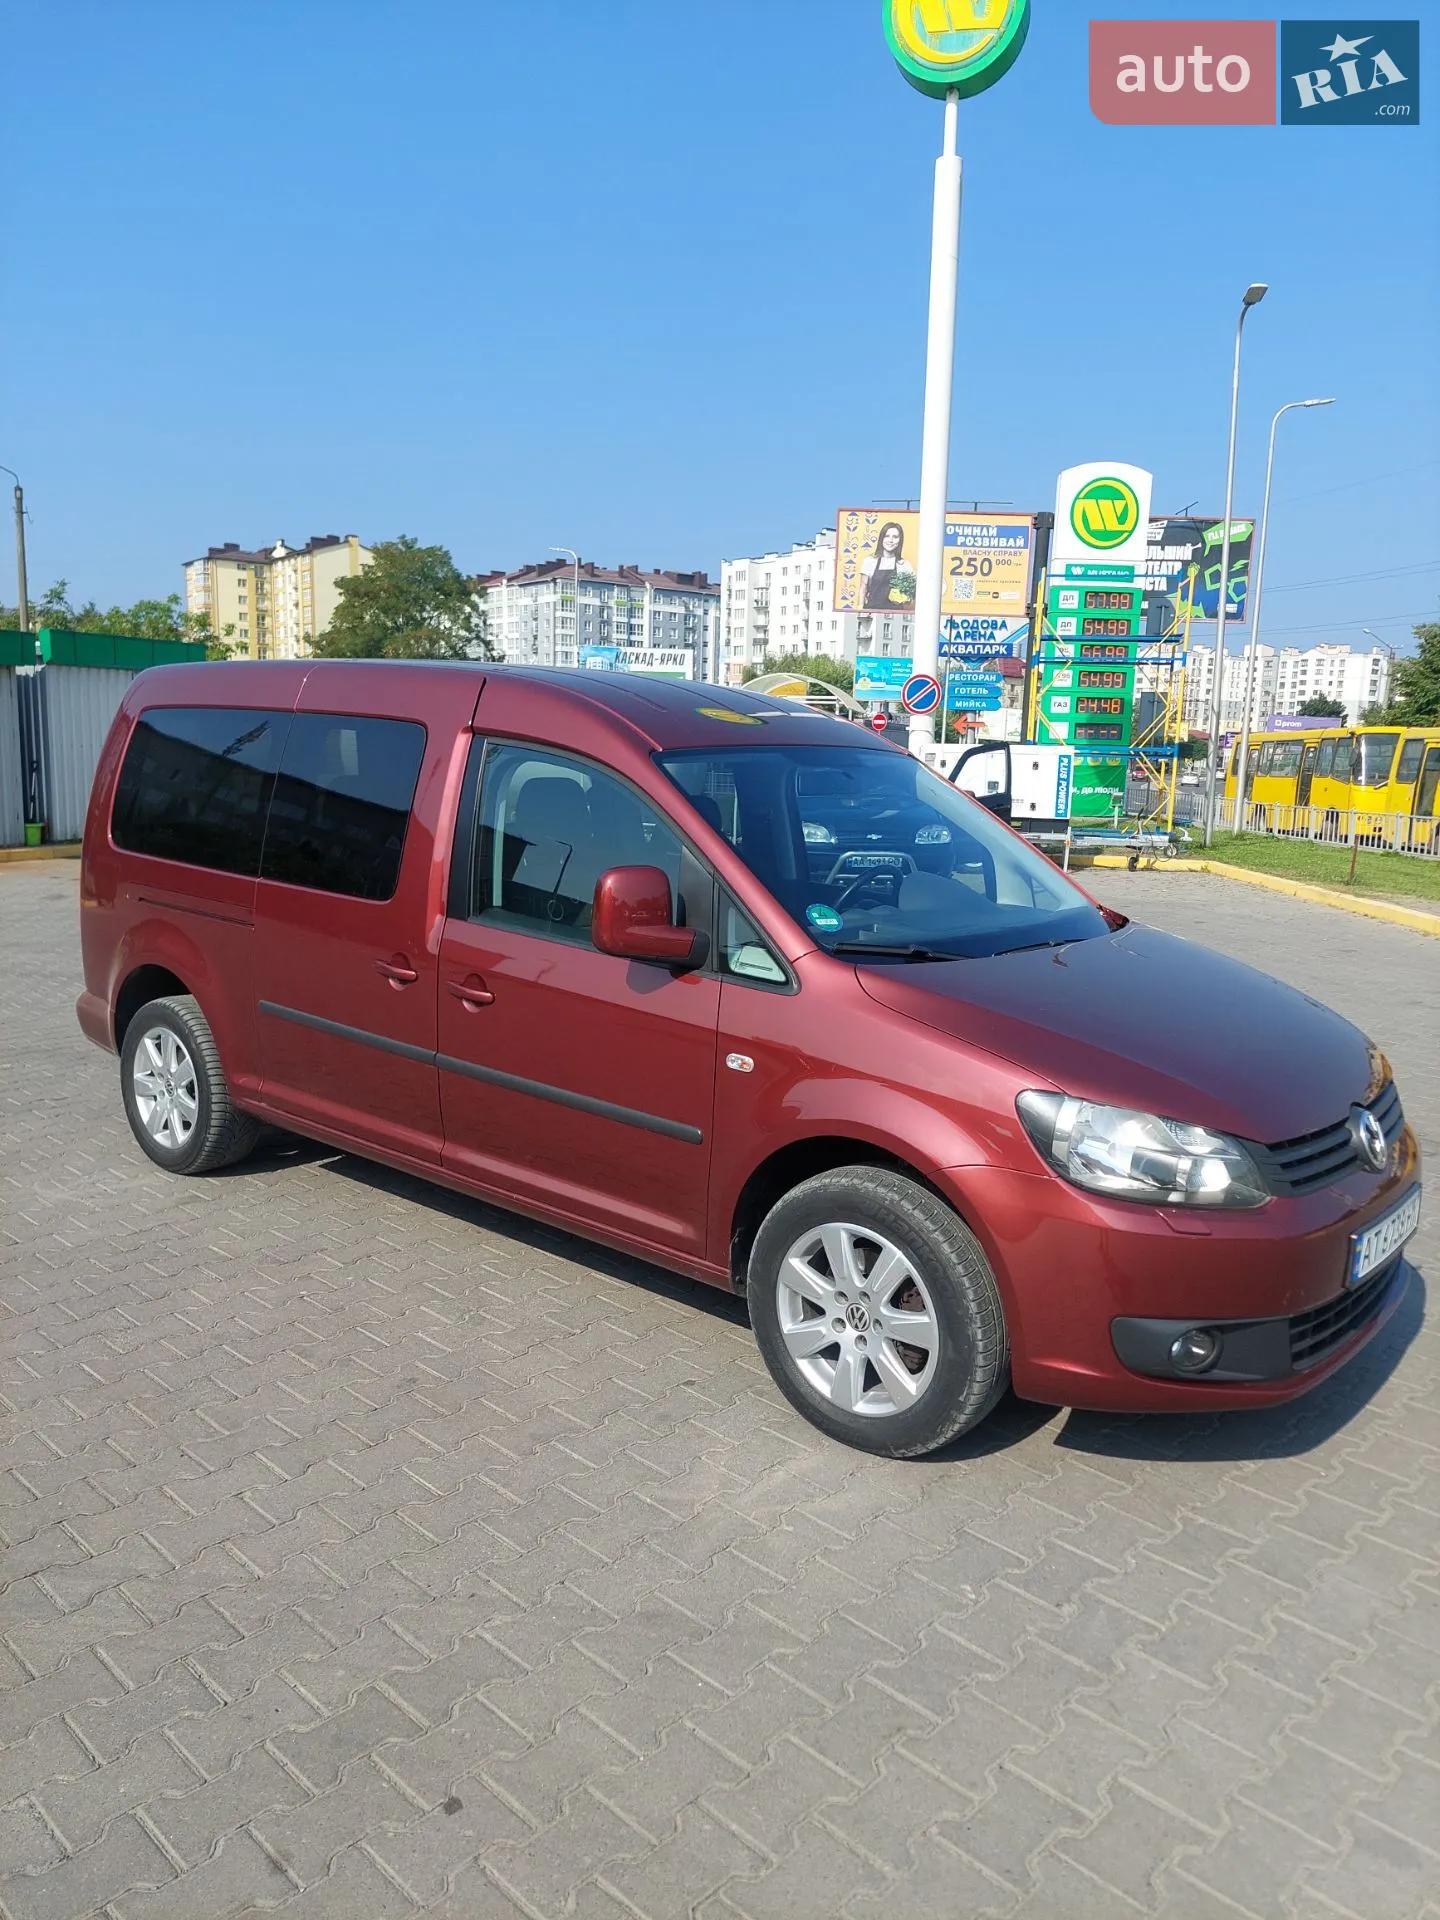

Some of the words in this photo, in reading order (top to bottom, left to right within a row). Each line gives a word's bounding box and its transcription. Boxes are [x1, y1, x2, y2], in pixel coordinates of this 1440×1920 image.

[946, 525, 998, 537] ОЧИНАЙ
[957, 535, 1024, 547] РОЗВИВАЙ
[1147, 542, 1192, 560] ЛЬШИЙ
[950, 556, 993, 576] 250
[995, 558, 1012, 566] 000
[1146, 561, 1182, 576] ТЕАТР
[944, 618, 1008, 631] ЛЬОДОВА
[954, 630, 996, 641] АРЕНА
[941, 644, 1007, 655] АКВАПАРК
[949, 673, 997, 682] РЕСТОРАН
[1080, 671, 1123, 688] 54.99
[954, 687, 989, 695] ГОТЕЛЬ
[955, 700, 987, 708] МИЙКА
